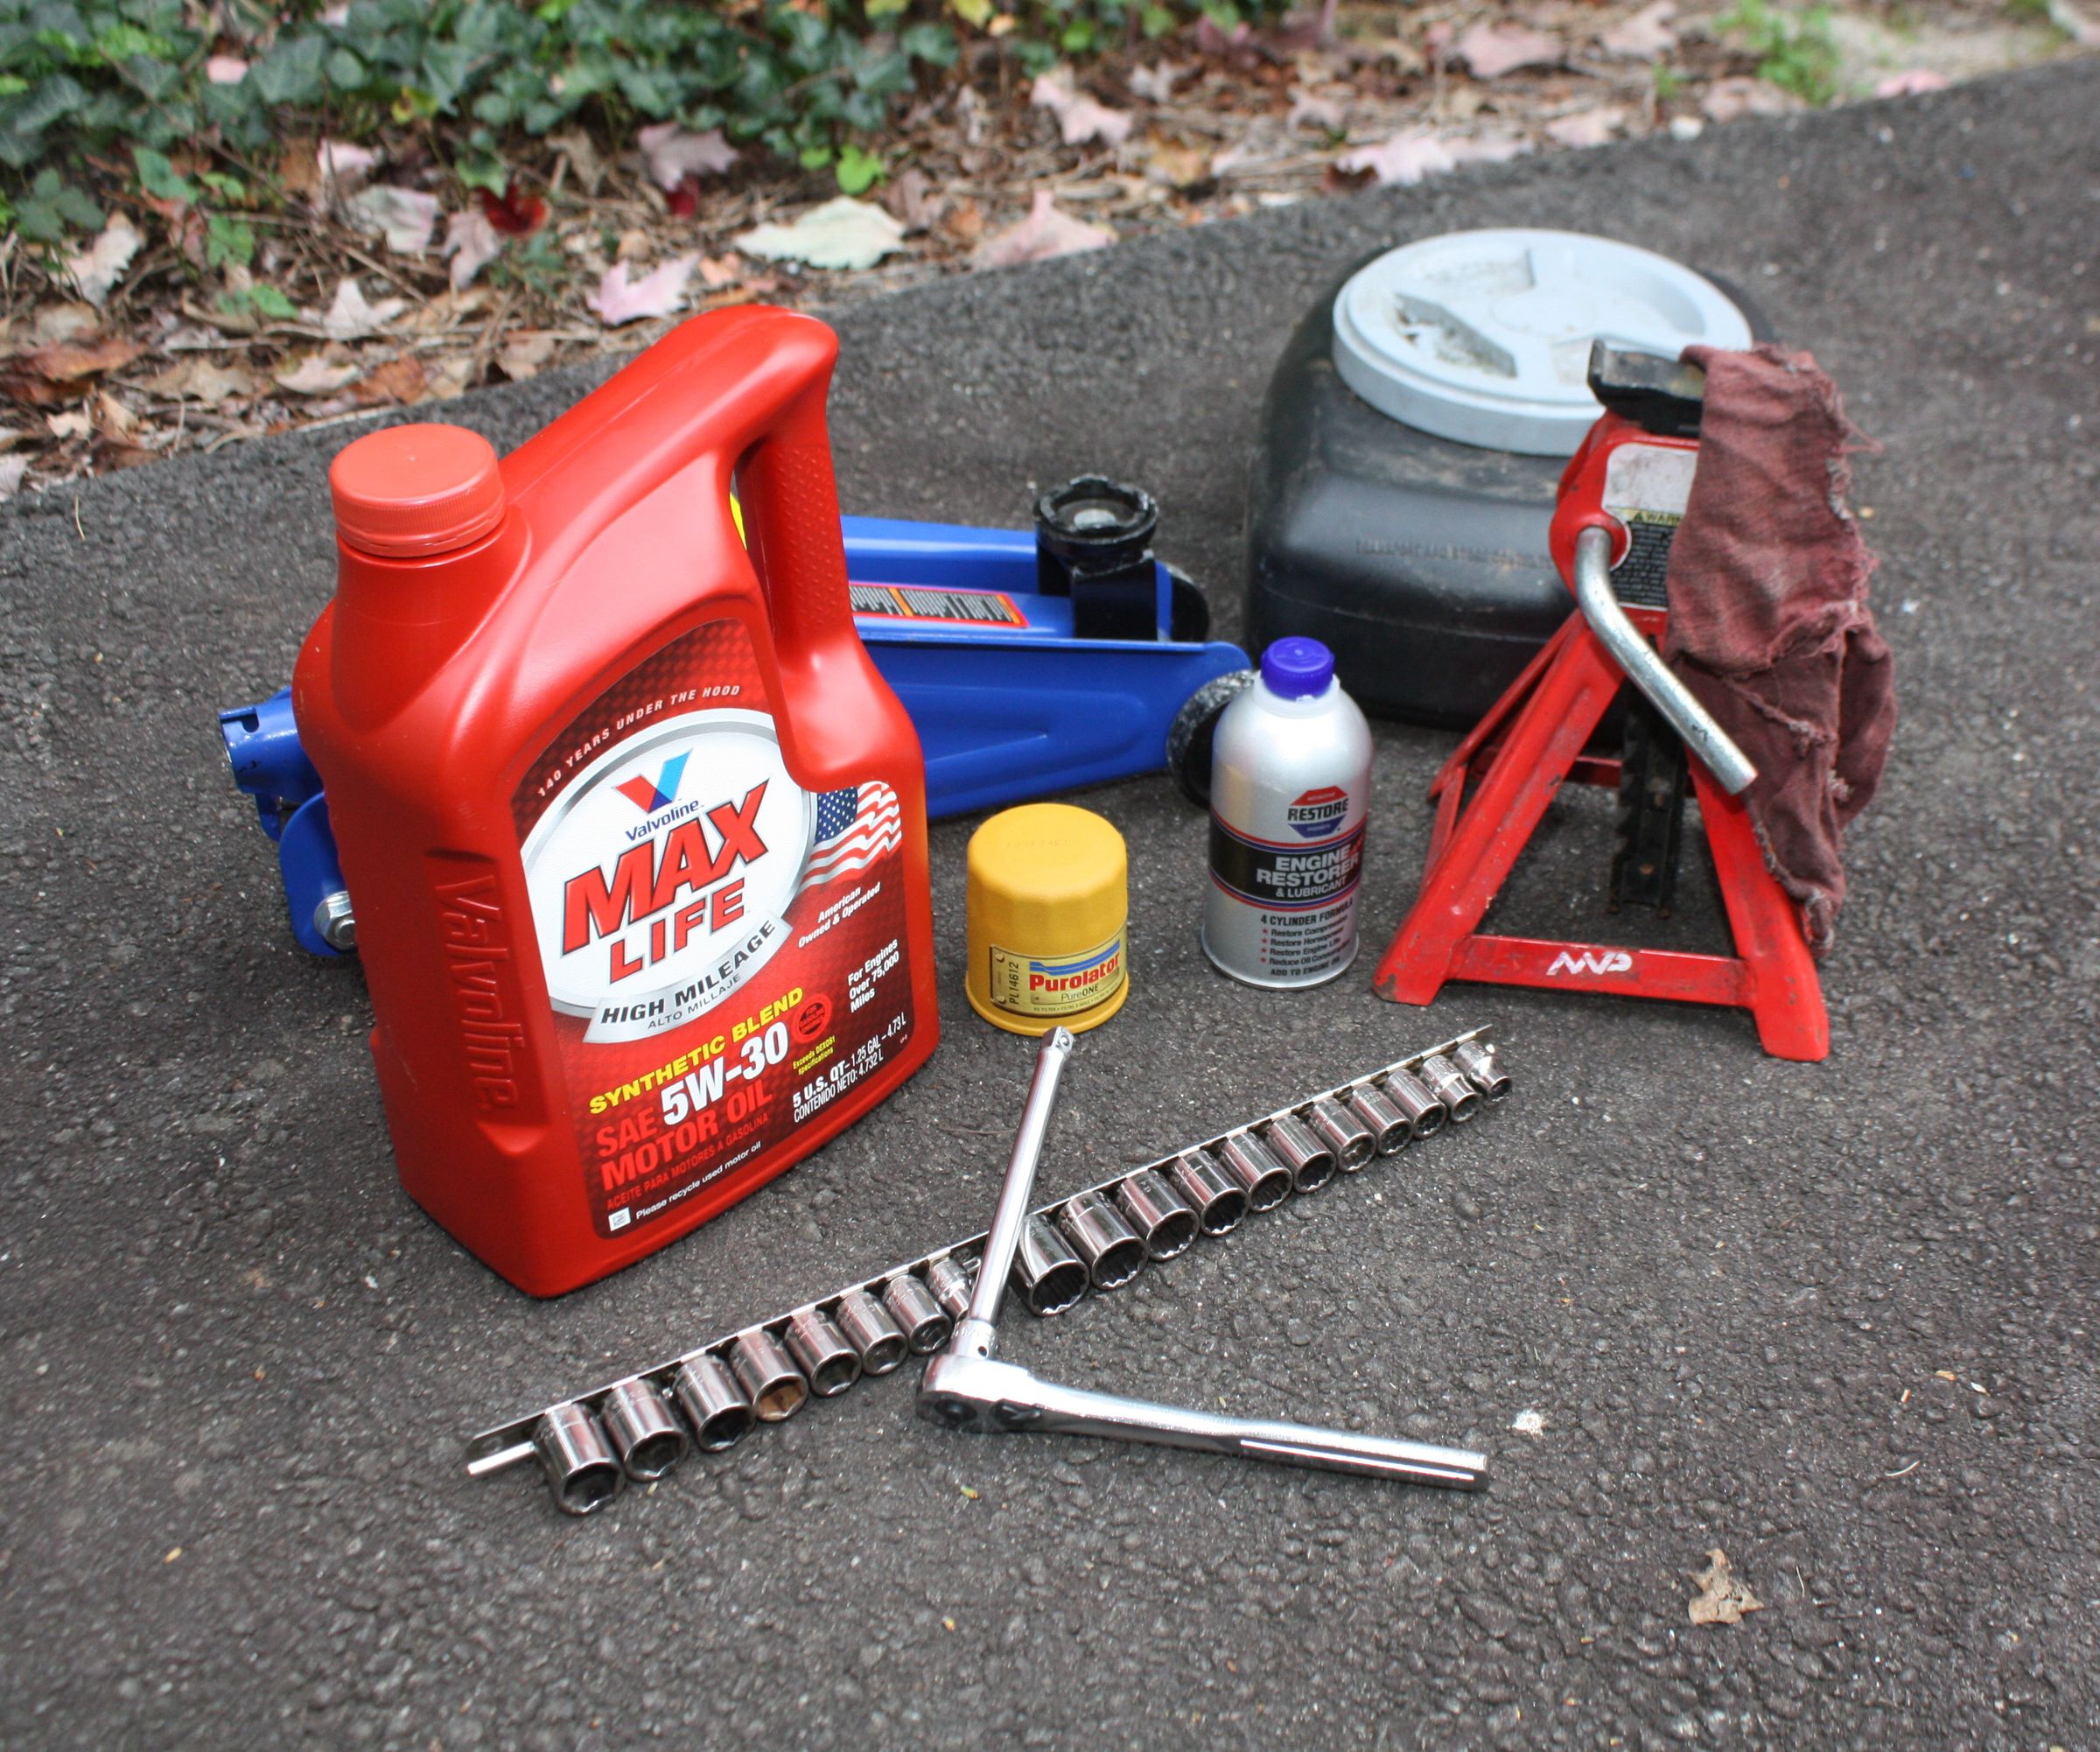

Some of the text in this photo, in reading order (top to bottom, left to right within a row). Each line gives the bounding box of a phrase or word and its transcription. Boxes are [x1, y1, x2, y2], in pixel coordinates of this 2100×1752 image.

[538, 685, 741, 797] 140 YEARS UNDER THE HOOD
[626, 800, 699, 842] Valvoline
[1287, 797, 1349, 821] RESTORE
[561, 777, 769, 957] MAX
[1256, 851, 1359, 887] RESTORER
[1275, 843, 1351, 872] ENGINE
[818, 887, 861, 923] American
[1276, 875, 1348, 898] & LUBRICANT
[610, 877, 746, 985] LIFE
[798, 881, 881, 948] Owned & Operated
[1261, 915, 1267, 924] 4
[1270, 915, 1317, 926] CYLINDER
[601, 920, 775, 1023] HIGH MILEAGE
[848, 939, 898, 986] For Engines
[849, 951, 900, 999] Over 75,000
[1008, 962, 1019, 1005] PL14612
[1029, 951, 1121, 992] Purolator
[435, 875, 525, 1111] Valvoline
[648, 973, 741, 1030] ALTO MILLAJE
[850, 988, 875, 1013] Miles
[1060, 984, 1099, 1002] PureONE
[589, 1035, 725, 1114] SYNTHETIC
[732, 987, 803, 1043] BLEND
[793, 1050, 815, 1069] Exceeds
[793, 1091, 802, 1108] 5
[803, 1076, 828, 1100] U.S.
[851, 1045, 866, 1067] 1.25
[867, 1034, 881, 1054] GAL
[887, 1015, 901, 1038] 4.73
[901, 1012, 906, 1025] L
[597, 1021, 788, 1158] SAE 5W-30
[794, 1048, 884, 1123] CONTENIDO NETO: 4.732 L
[601, 1079, 774, 1191] MOTOR OIL
[607, 1113, 769, 1211] ACEITE PARA MOTORES A GASOLINA
[635, 1140, 761, 1219] Please recycle used motor oil
